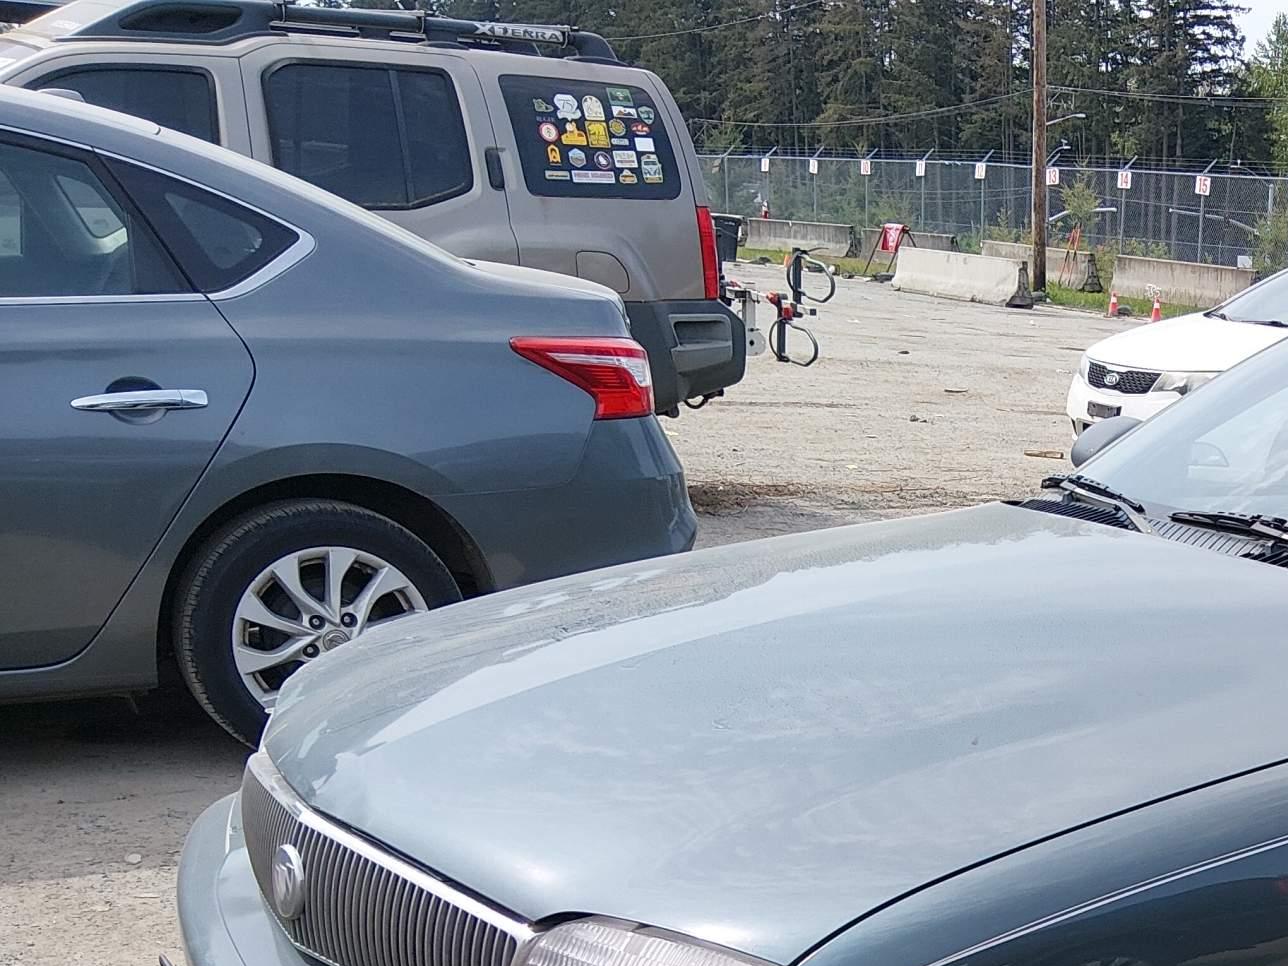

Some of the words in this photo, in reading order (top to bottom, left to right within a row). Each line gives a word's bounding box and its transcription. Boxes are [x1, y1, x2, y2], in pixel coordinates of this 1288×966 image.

[473, 22, 561, 41] XTERRA
[862, 161, 869, 173] 10
[917, 162, 923, 175] 11
[976, 164, 984, 177] 12
[1049, 167, 1057, 184] 13
[1119, 172, 1129, 187] 14
[1198, 177, 1208, 194] 15
